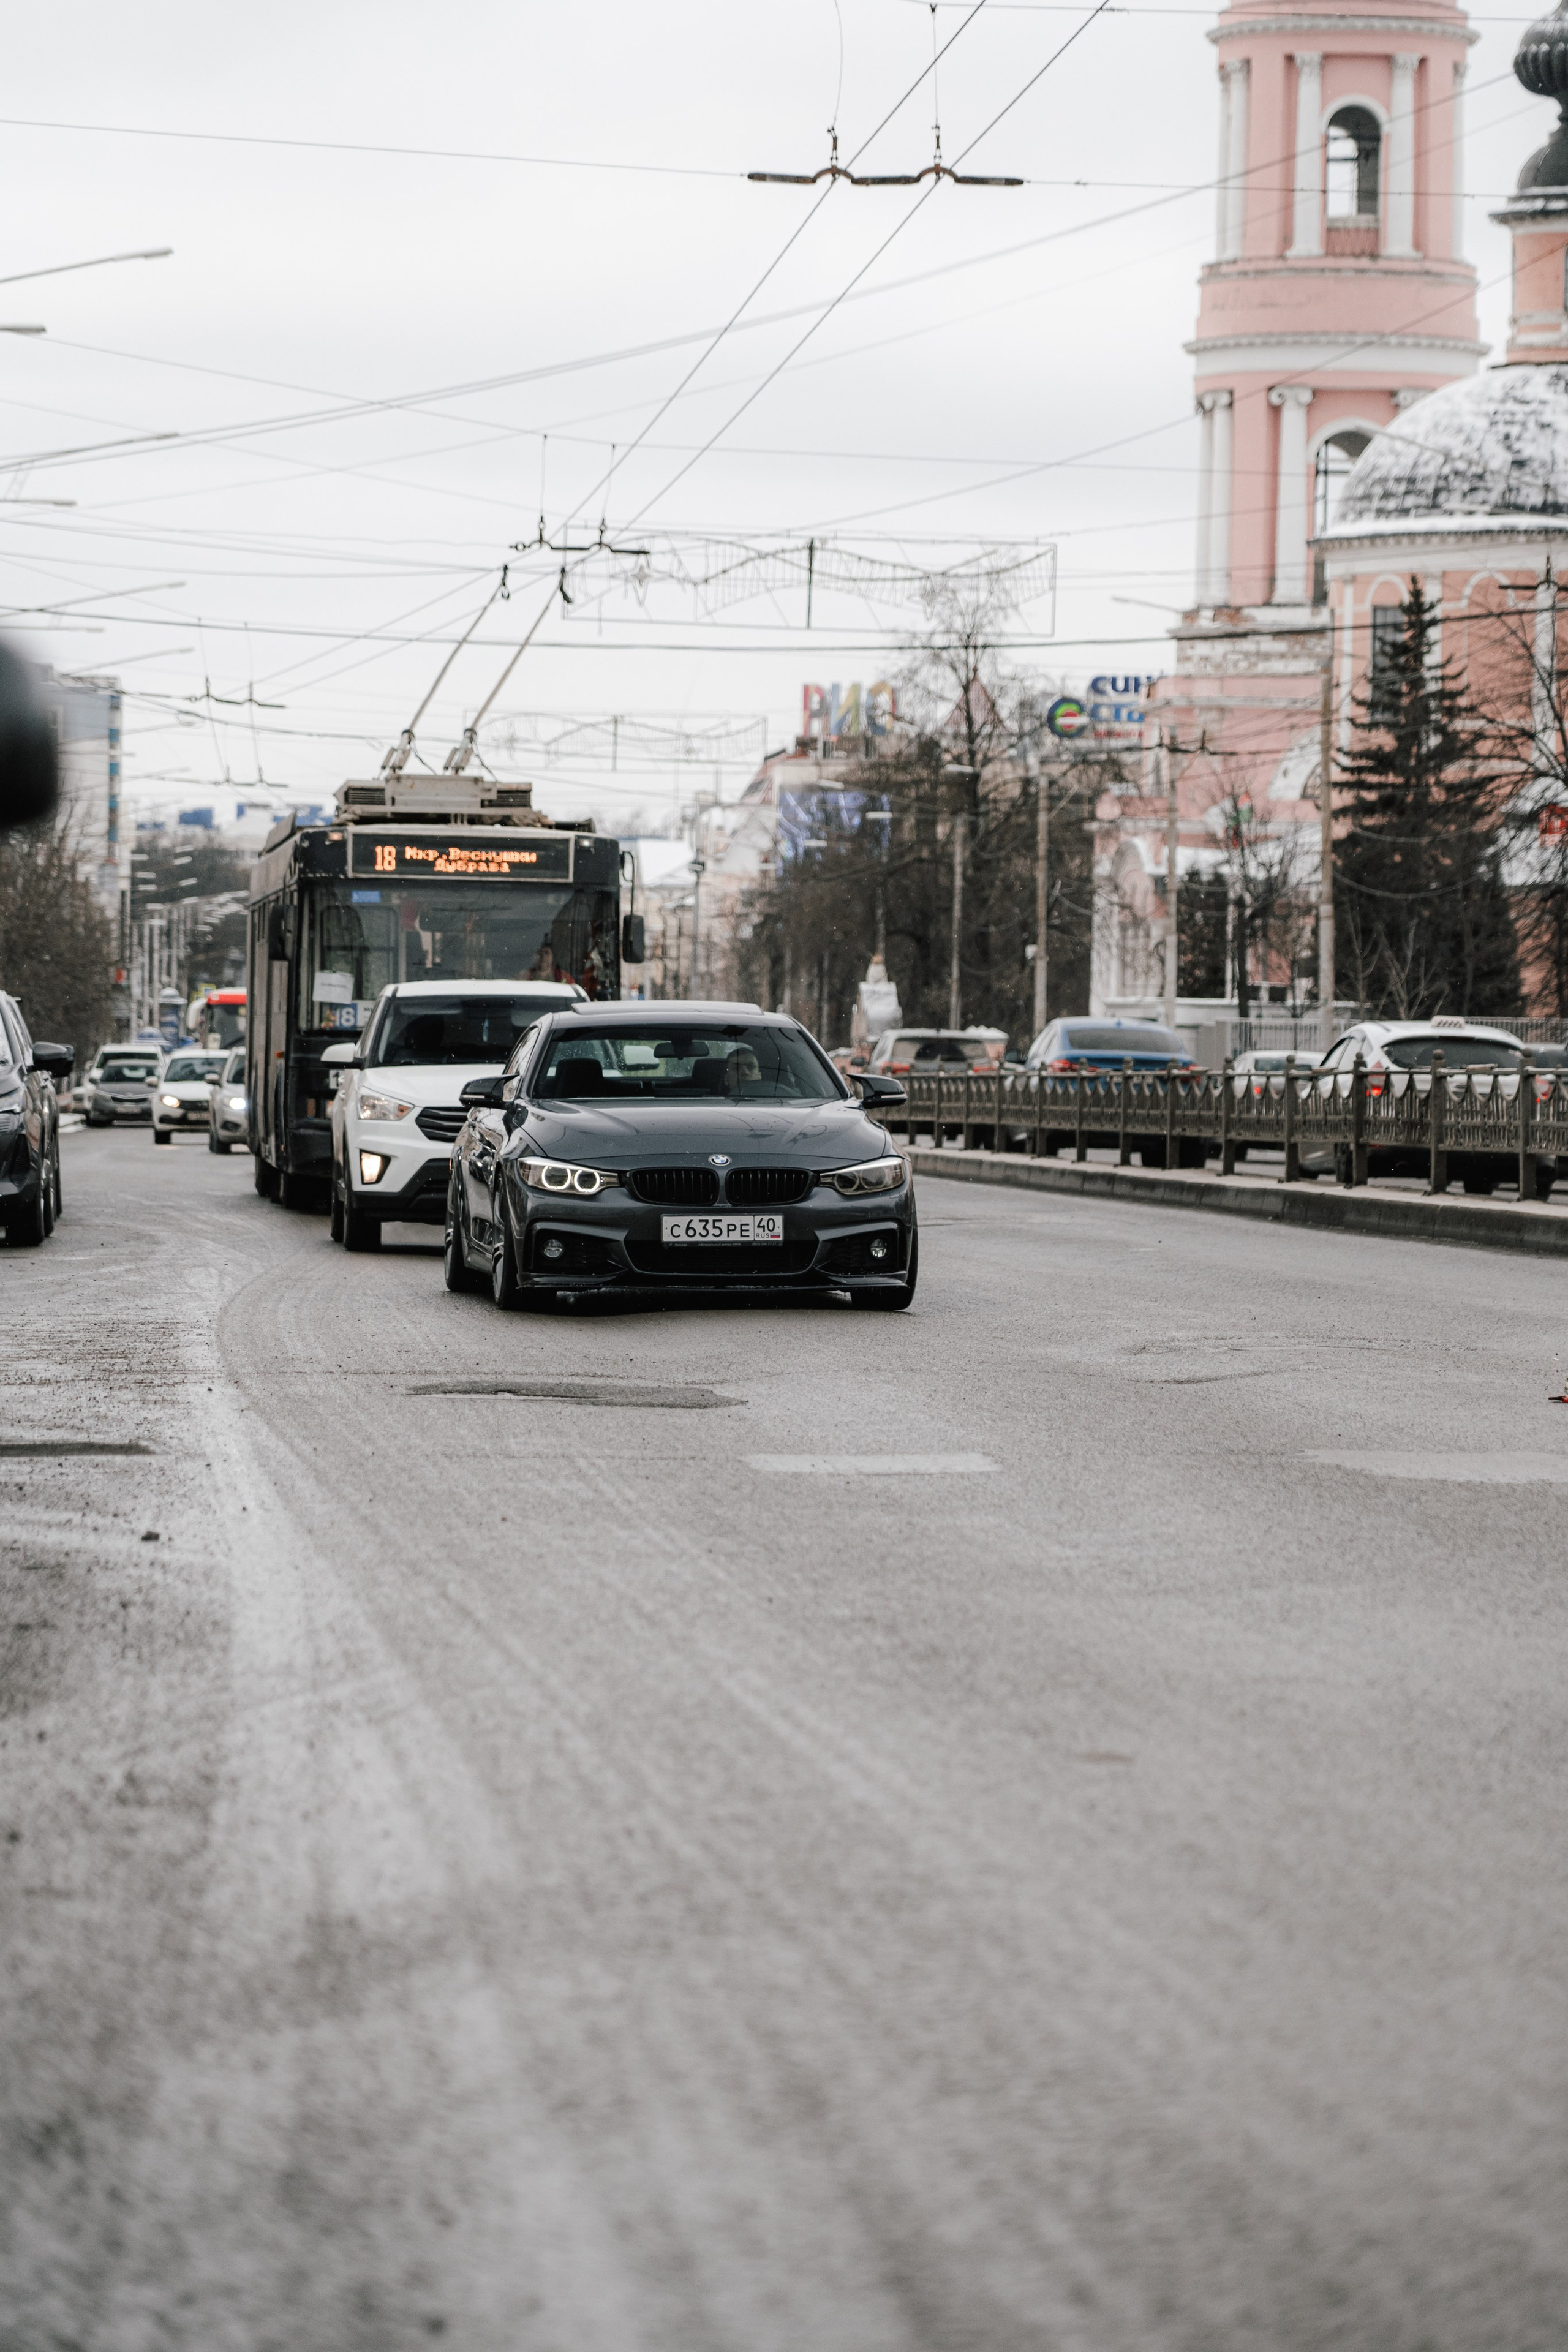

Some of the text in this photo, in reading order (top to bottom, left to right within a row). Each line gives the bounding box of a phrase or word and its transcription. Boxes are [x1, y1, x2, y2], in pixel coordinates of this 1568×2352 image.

[375, 845, 396, 871] 18
[433, 858, 510, 873] Дубрава
[756, 1218, 776, 1233] 40
